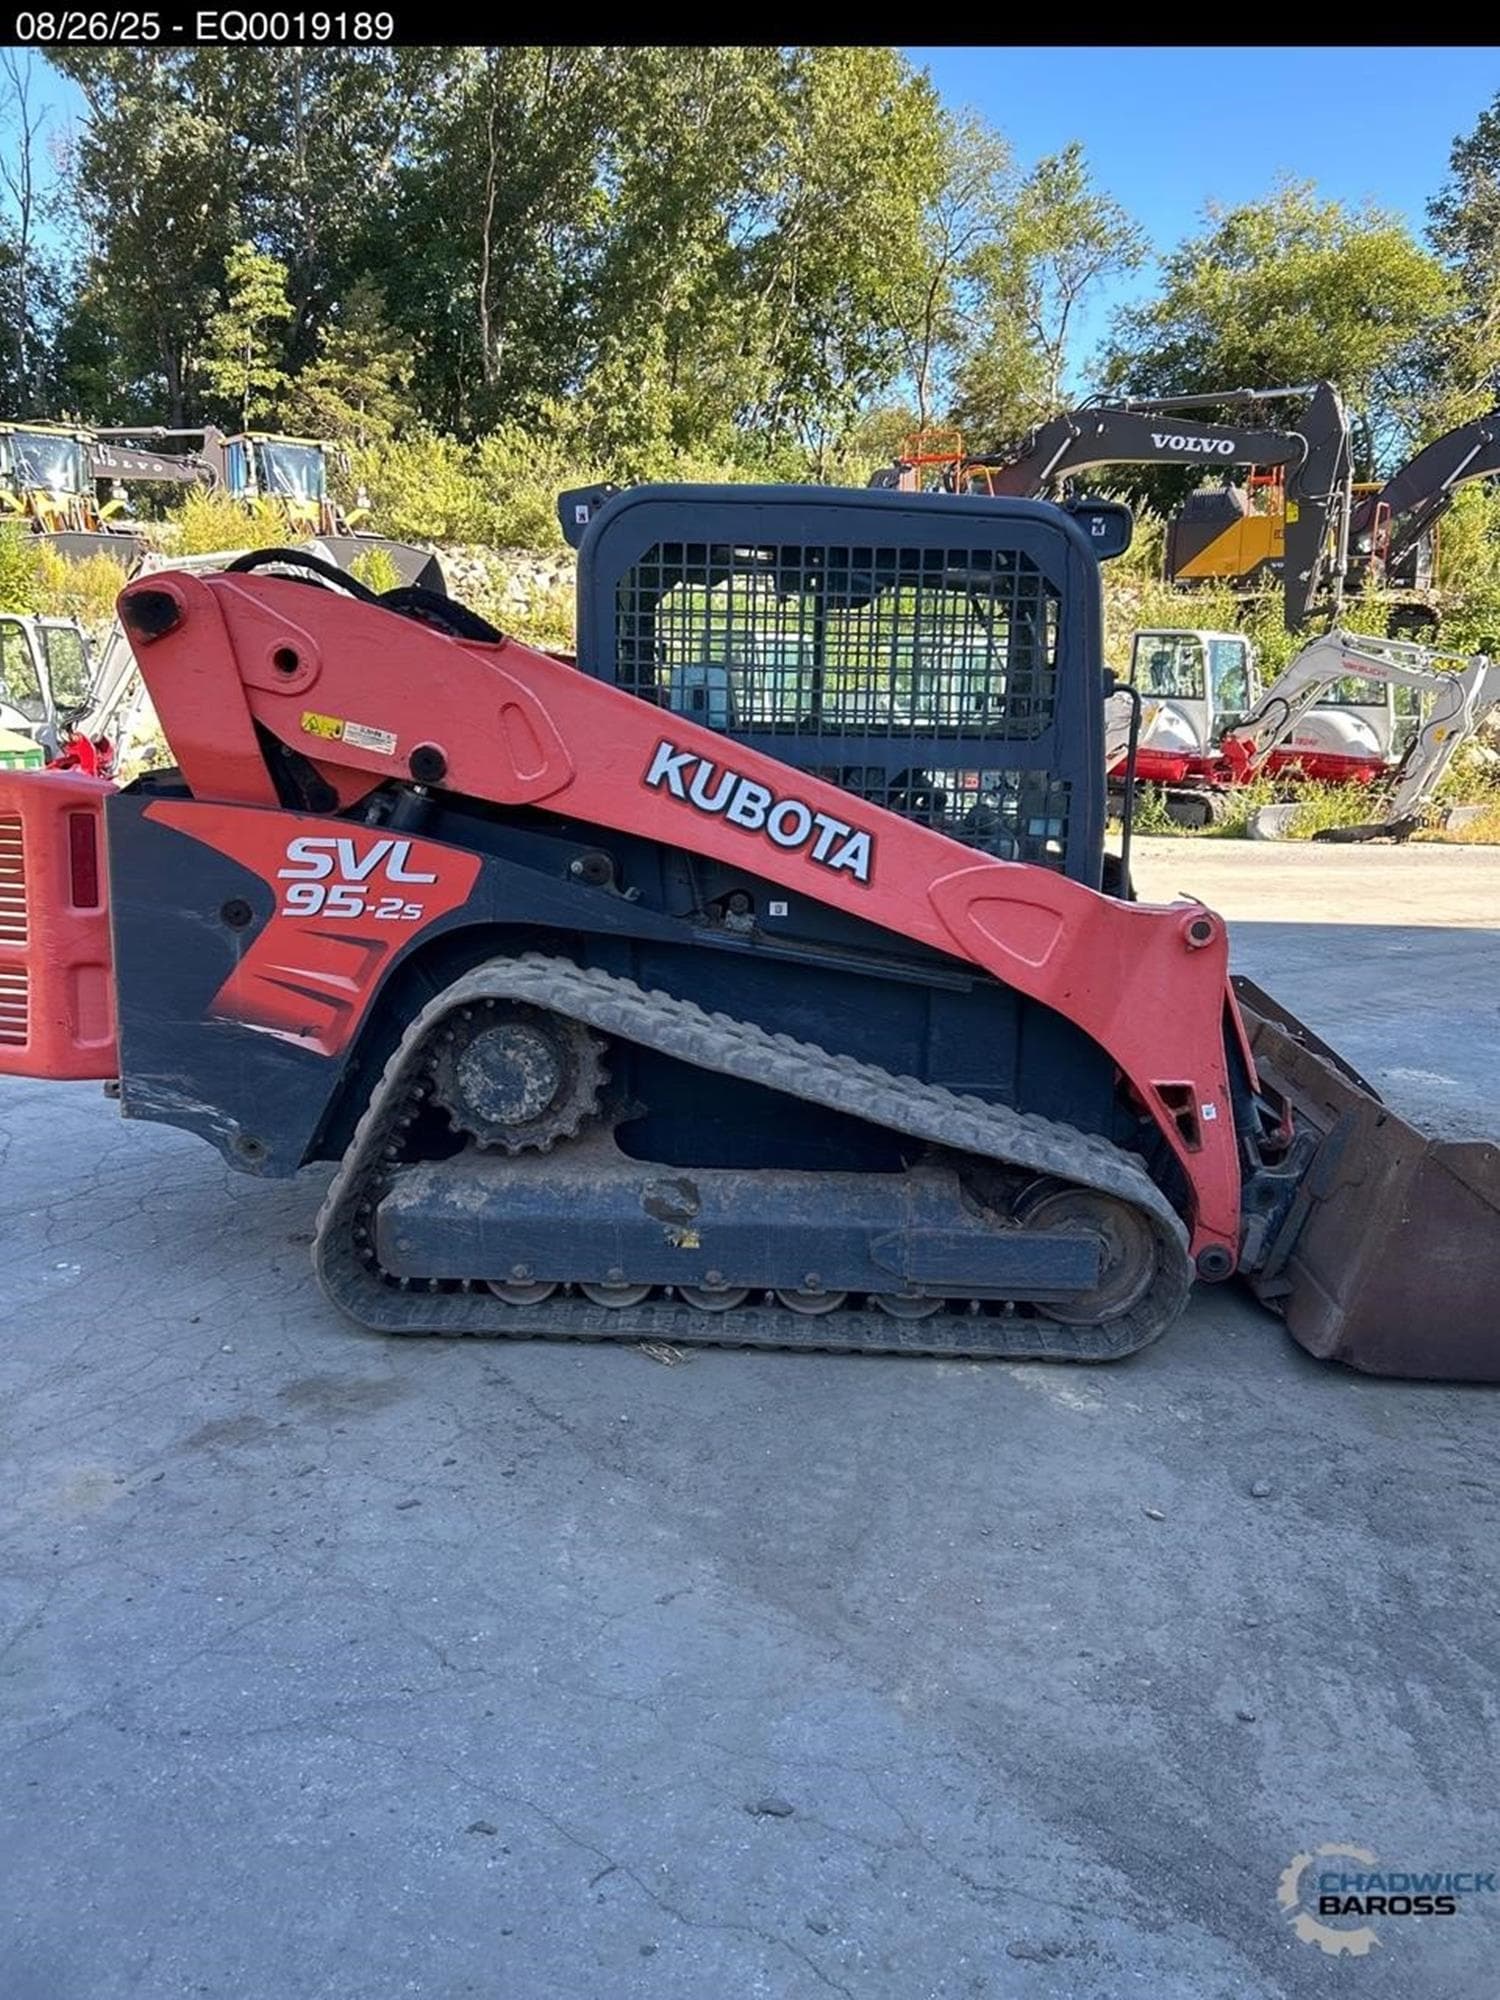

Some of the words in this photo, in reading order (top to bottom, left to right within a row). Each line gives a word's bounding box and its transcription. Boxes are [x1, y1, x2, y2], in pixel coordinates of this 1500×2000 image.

[1151, 433, 1235, 455] VOLVO
[645, 741, 873, 881] KUBOTA
[277, 837, 437, 883] SVL
